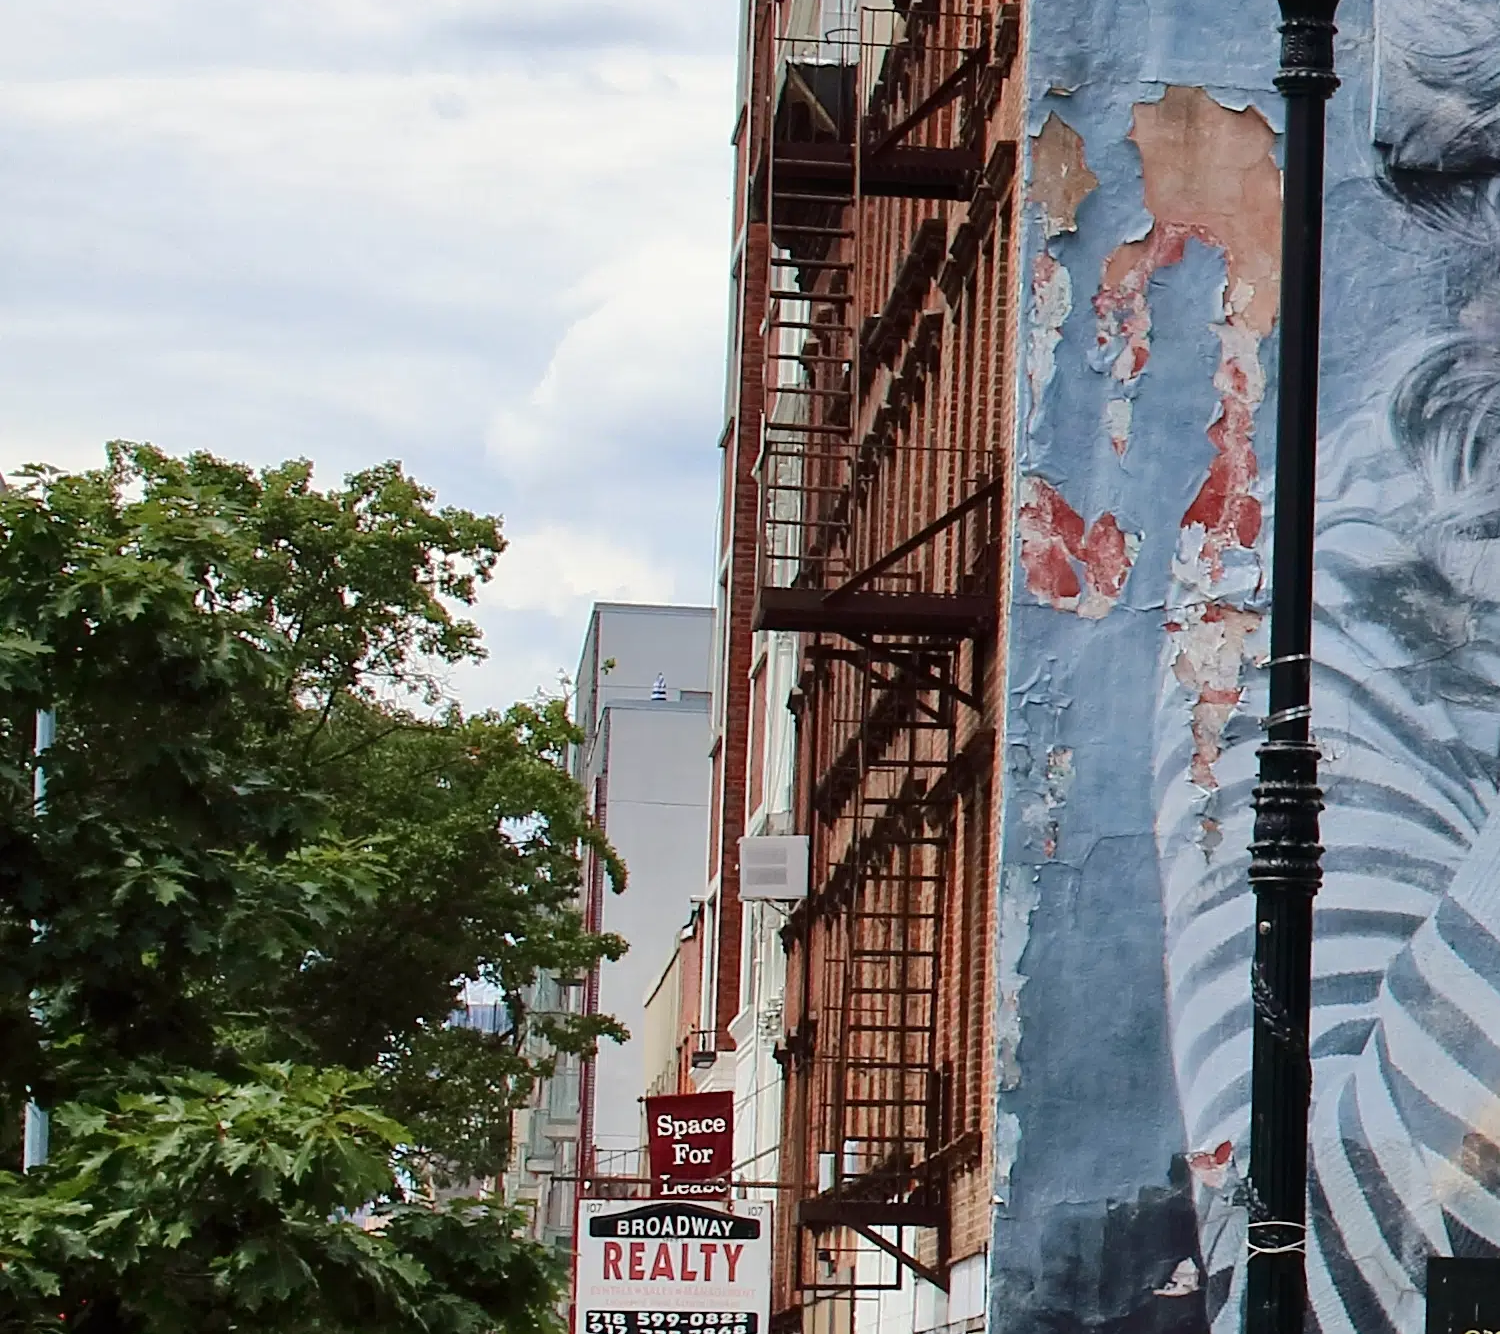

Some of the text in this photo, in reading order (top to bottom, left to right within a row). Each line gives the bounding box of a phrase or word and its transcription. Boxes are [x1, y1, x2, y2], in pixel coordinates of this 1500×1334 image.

[656, 1114, 727, 1140] Space
[672, 1143, 714, 1166] For
[616, 1215, 735, 1238] BROADWAY
[603, 1241, 744, 1283] REALTY
[587, 1312, 749, 1327] 718 599-0822
